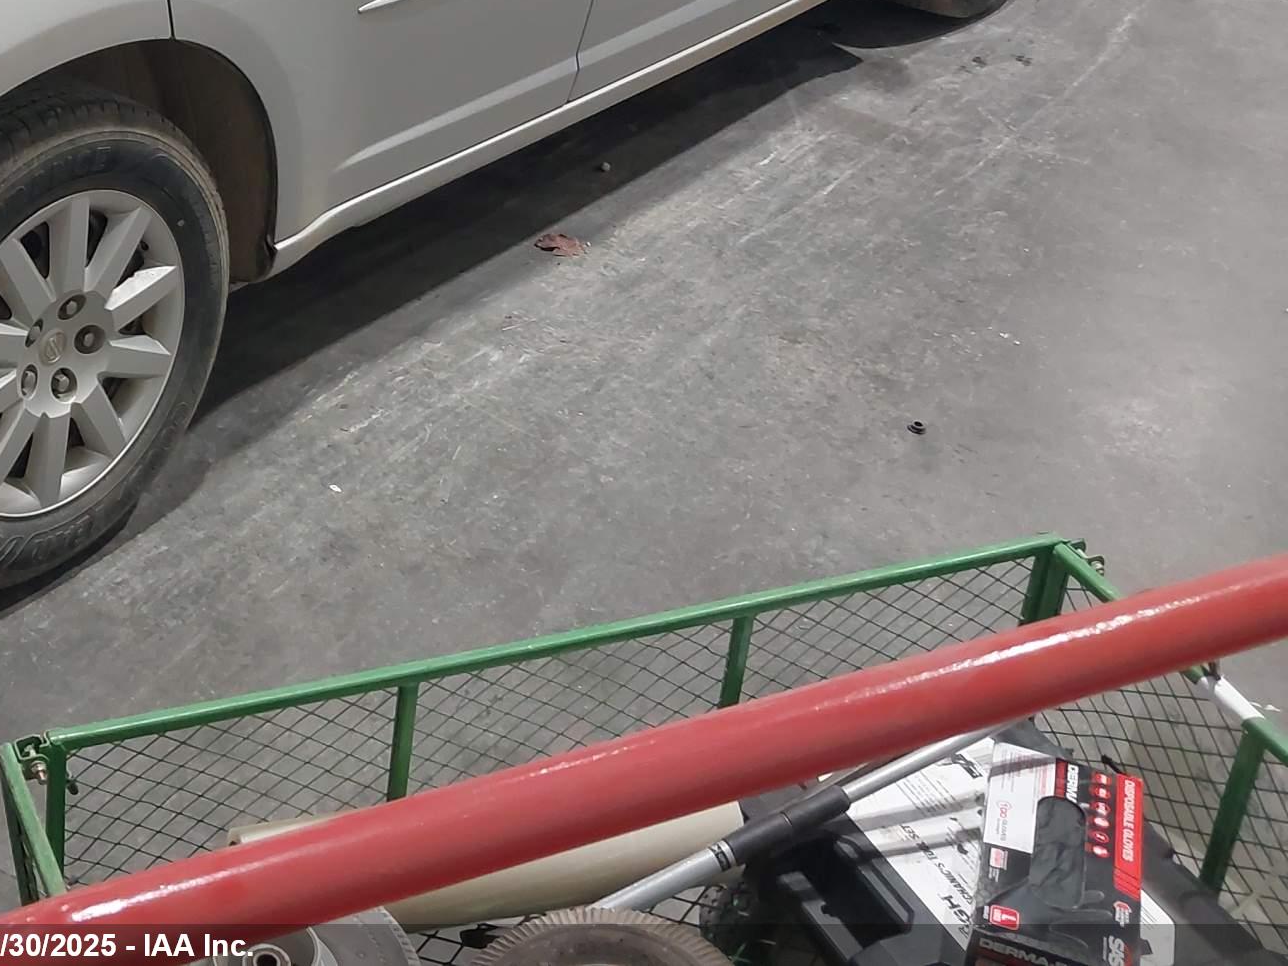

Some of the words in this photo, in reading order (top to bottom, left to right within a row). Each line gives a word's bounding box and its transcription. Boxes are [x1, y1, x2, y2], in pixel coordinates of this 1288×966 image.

[1123, 779, 1136, 829] DISPOSABLE
[899, 823, 920, 840] SET
[1122, 829, 1135, 863] GLOVES
